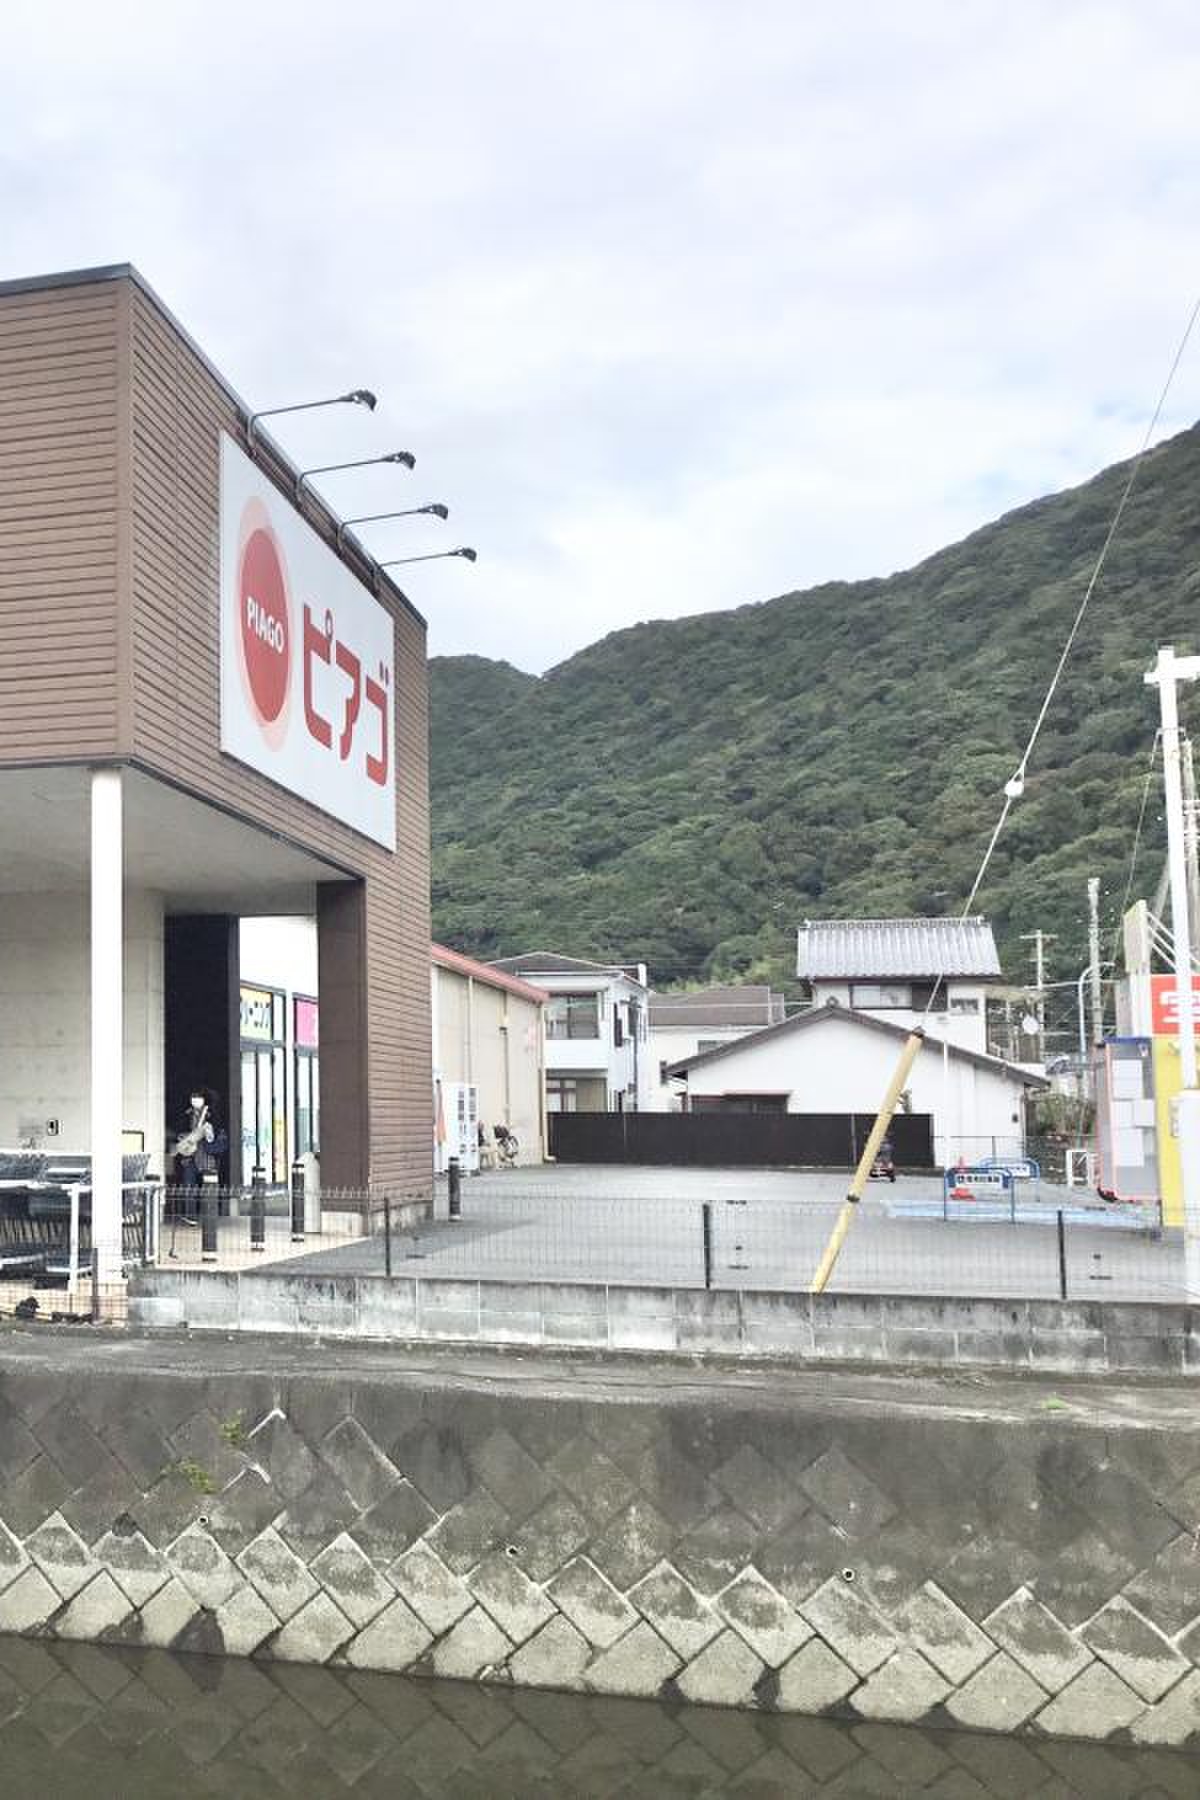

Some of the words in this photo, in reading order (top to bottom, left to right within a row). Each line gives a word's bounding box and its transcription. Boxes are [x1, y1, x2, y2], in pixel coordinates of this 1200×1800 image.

[247, 596, 284, 654] PIAGO
[304, 603, 388, 786] ピアゴ
